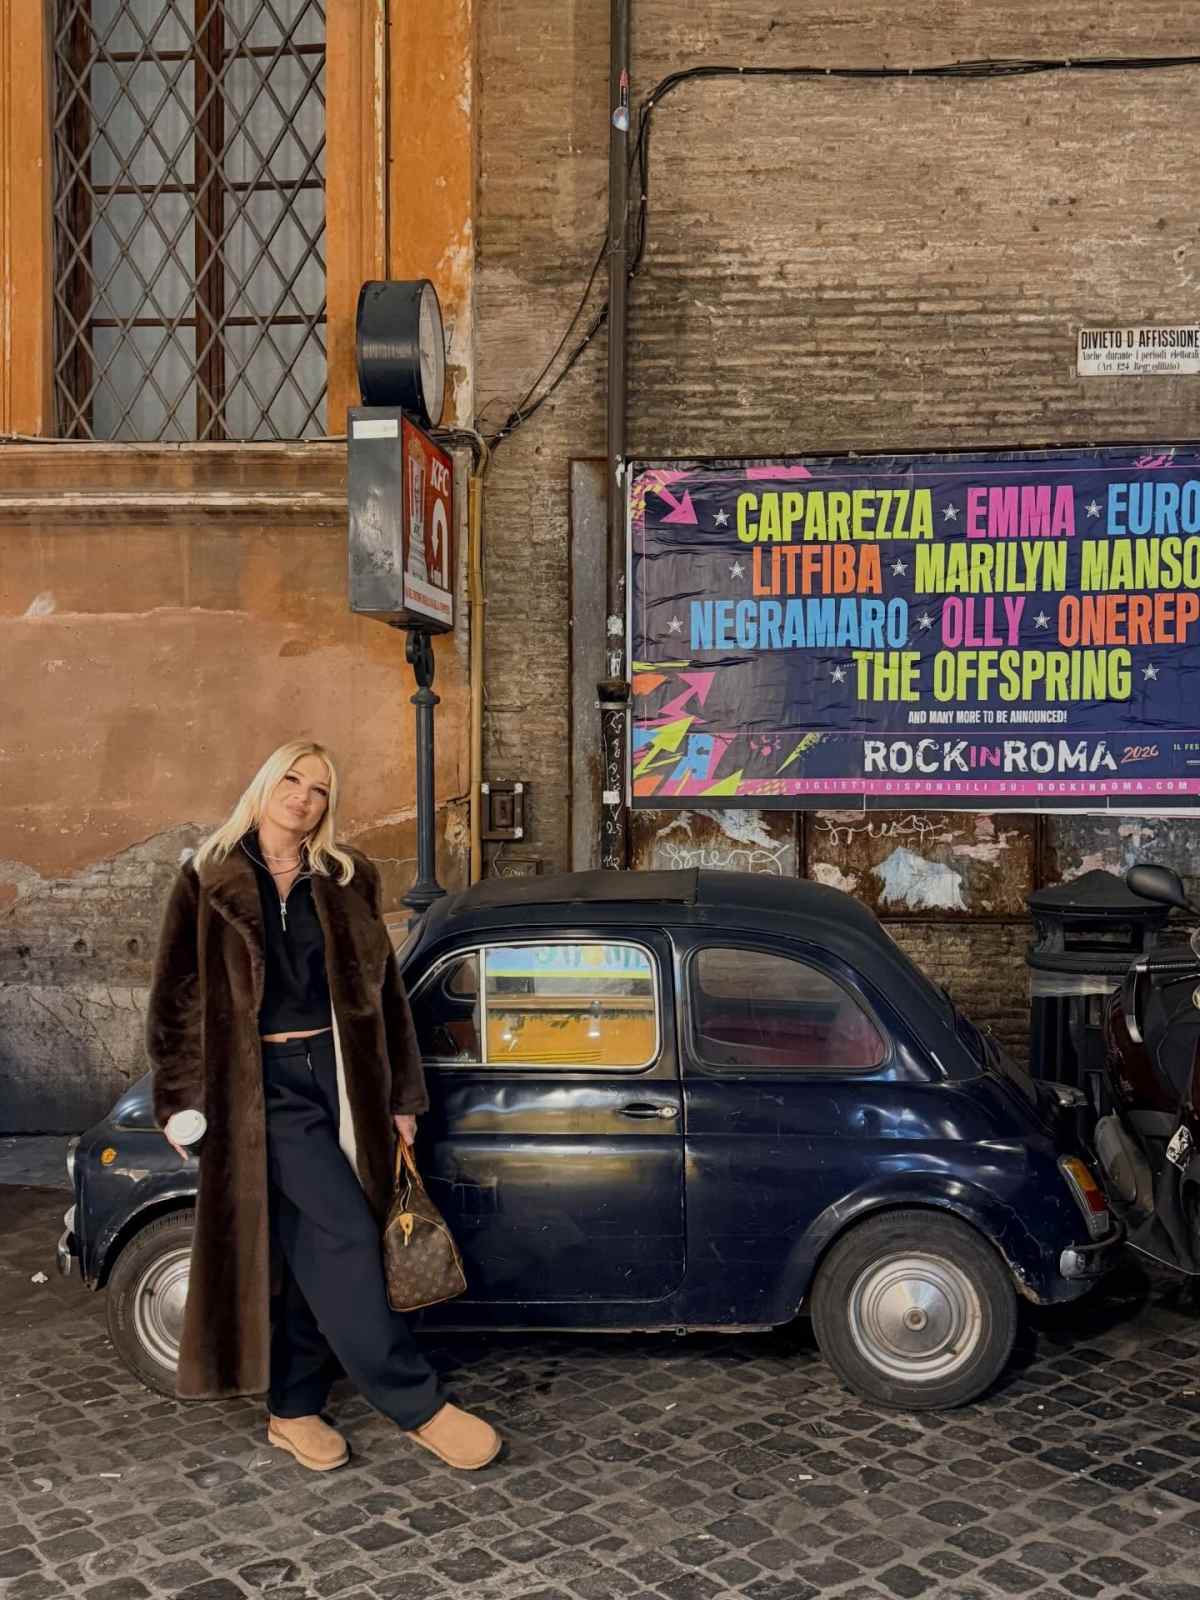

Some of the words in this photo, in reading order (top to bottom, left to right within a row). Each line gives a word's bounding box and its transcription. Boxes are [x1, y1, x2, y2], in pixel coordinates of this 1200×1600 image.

[1081, 330, 1121, 349] DIVIETO
[1138, 329, 1200, 348] AFFISSIONE
[431, 456, 449, 497] KFC
[737, 488, 934, 543] CAPAREZZA
[966, 484, 1076, 538] EMMA
[1107, 480, 1200, 535] EURO
[752, 543, 883, 596] LITFIBA
[914, 540, 1068, 594] MARILYN
[1080, 535, 1200, 591] MANSO
[690, 597, 909, 650] NEGRAMARO
[942, 596, 1026, 648] OLLY
[1058, 592, 1200, 647] ONEREP
[852, 651, 921, 701] THE
[933, 648, 1132, 701] OFFSPRING
[908, 710, 927, 724] AND
[929, 710, 954, 724] MANY
[956, 710, 981, 723] MORE
[983, 710, 994, 723] TO
[996, 710, 1008, 723] BE
[1009, 710, 1068, 723] ANNOUNCED!
[1121, 744, 1160, 764] 2026
[885, 782, 989, 791] DISPONIBILI
[1037, 781, 1188, 792] ROCKINROMA.COM
